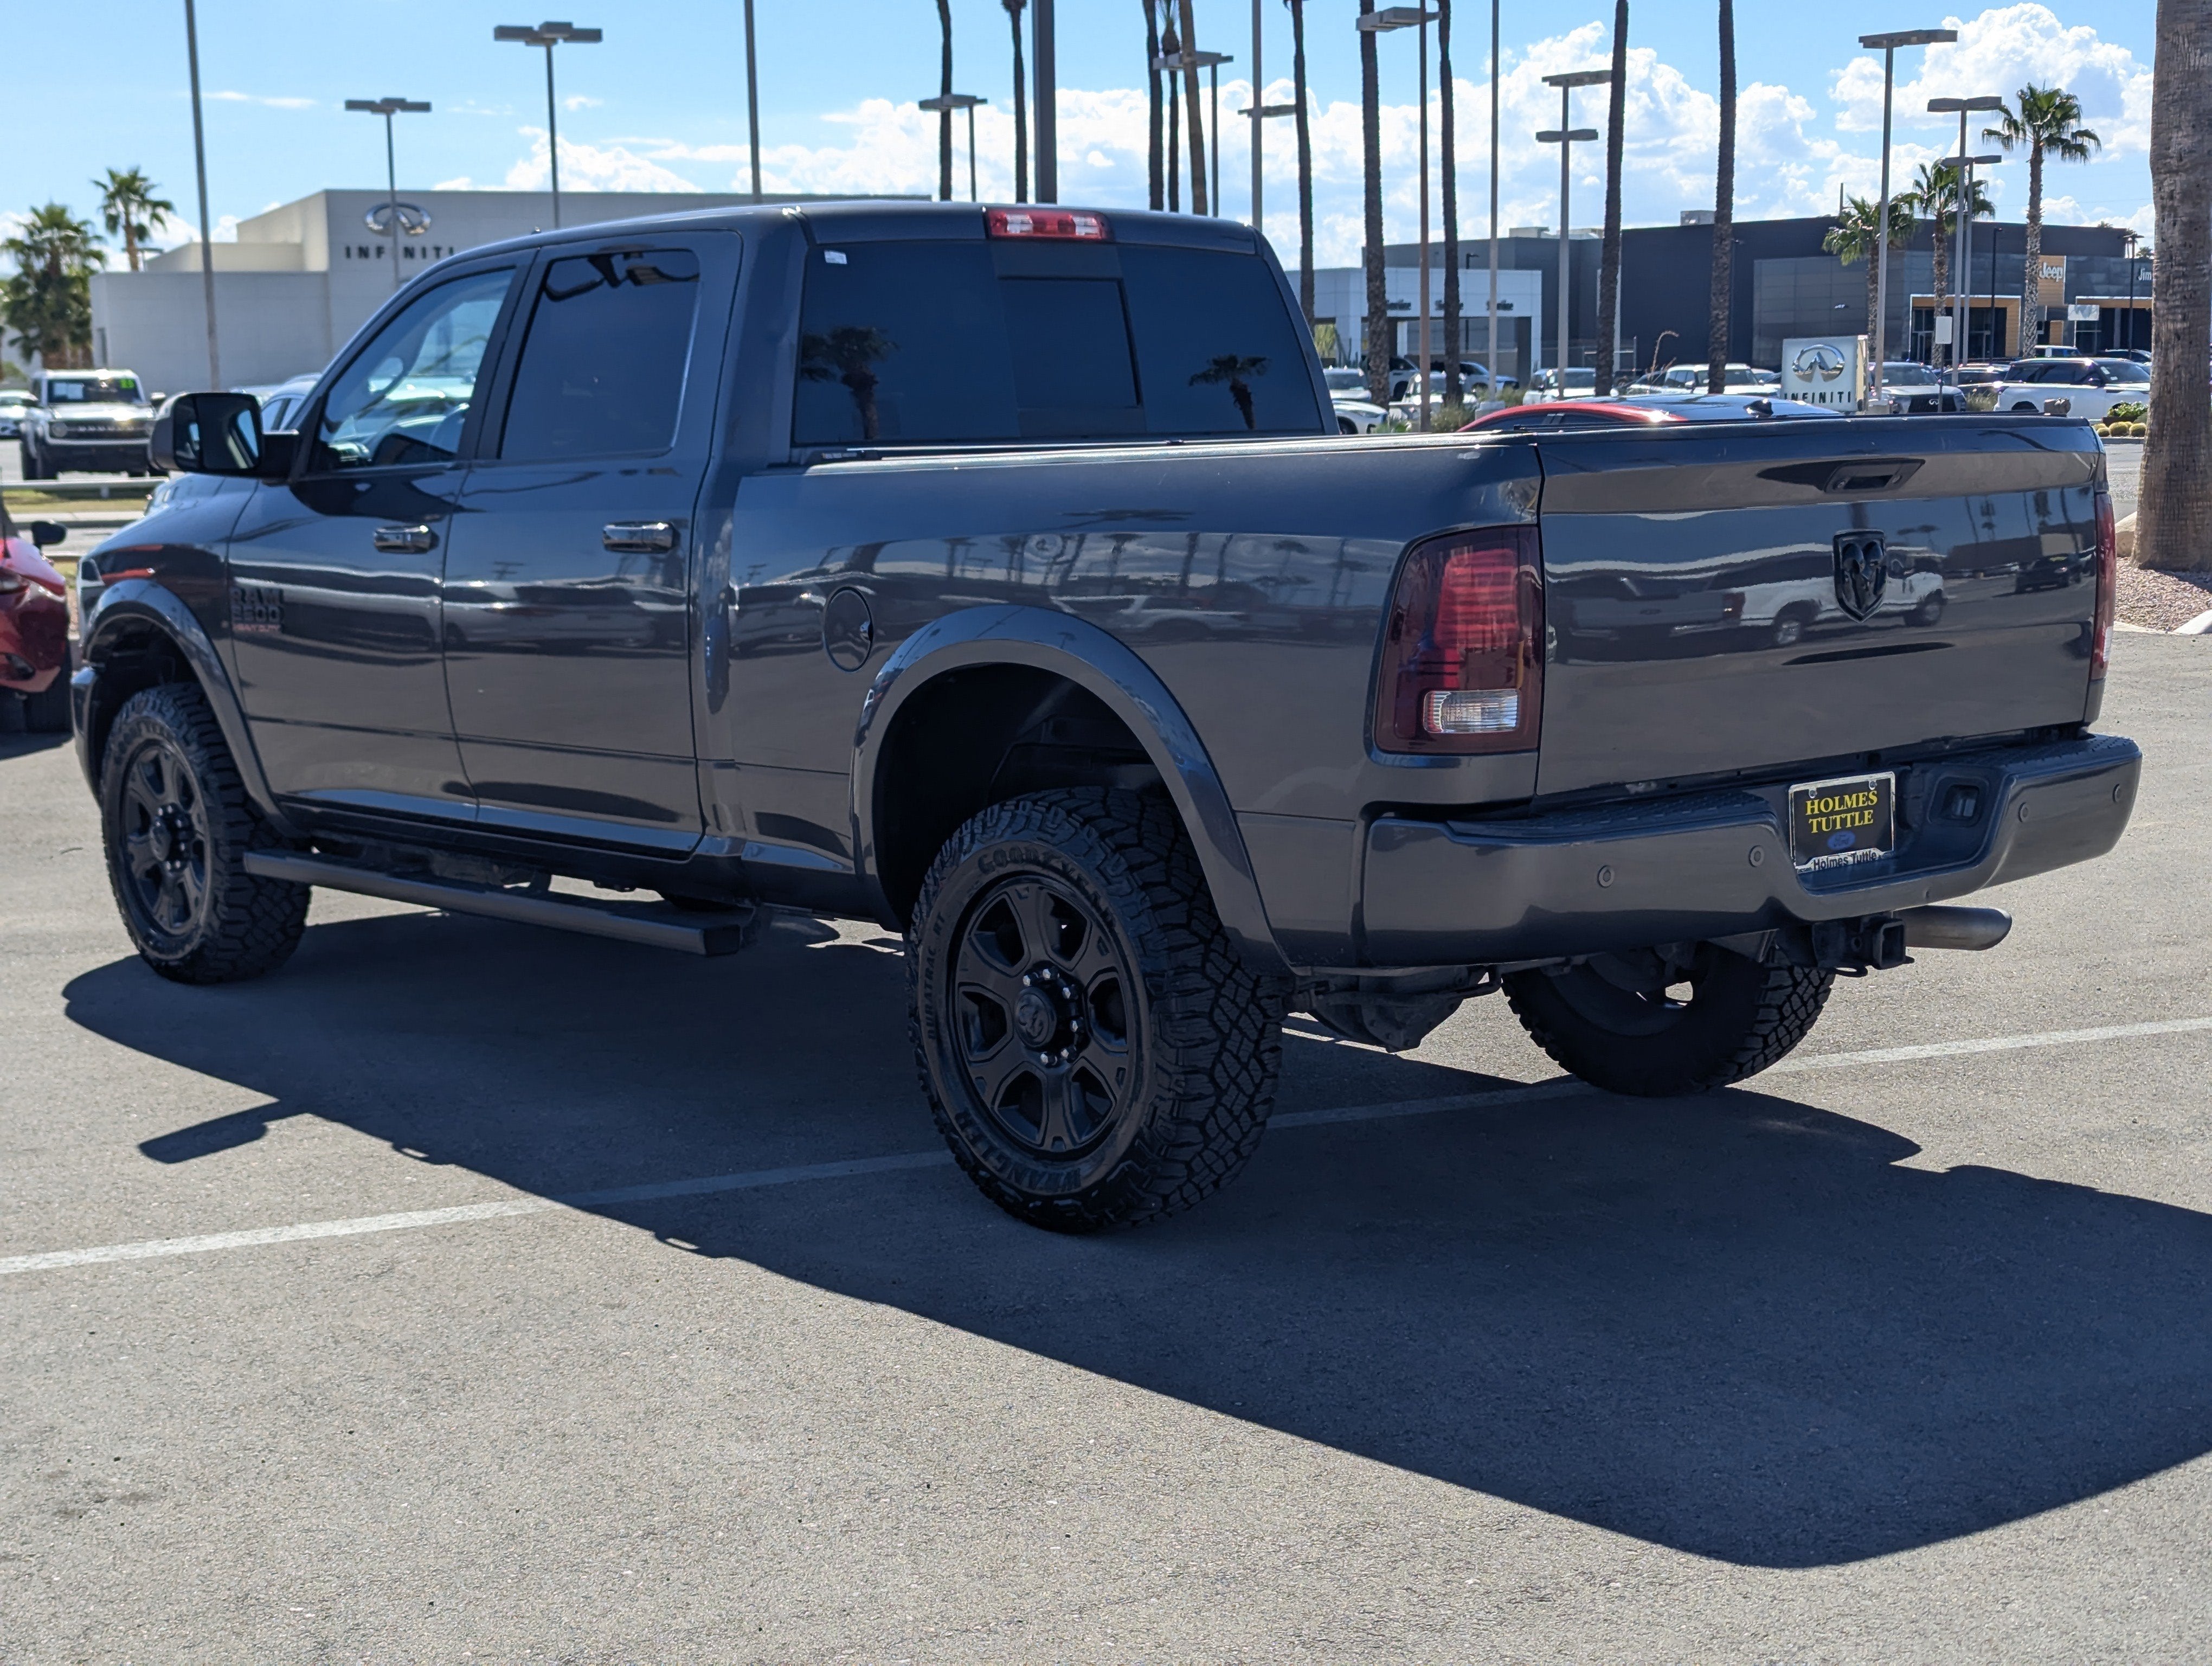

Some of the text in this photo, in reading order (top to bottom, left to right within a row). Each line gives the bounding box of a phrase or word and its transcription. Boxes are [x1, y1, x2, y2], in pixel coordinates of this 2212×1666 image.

[345, 245, 453, 259] INFNITI
[2039, 261, 2063, 283] Jeep
[2138, 267, 2152, 281] Jim
[1784, 390, 1851, 403] INFINITI
[1805, 790, 1878, 816] HOLMES
[1808, 809, 1874, 834] TUTTLE
[1813, 854, 1849, 871] Holmes
[1850, 850, 1877, 864] Tuttle
[978, 844, 1116, 928] GOODYEAR
[924, 911, 945, 1040] DURATRAC RT
